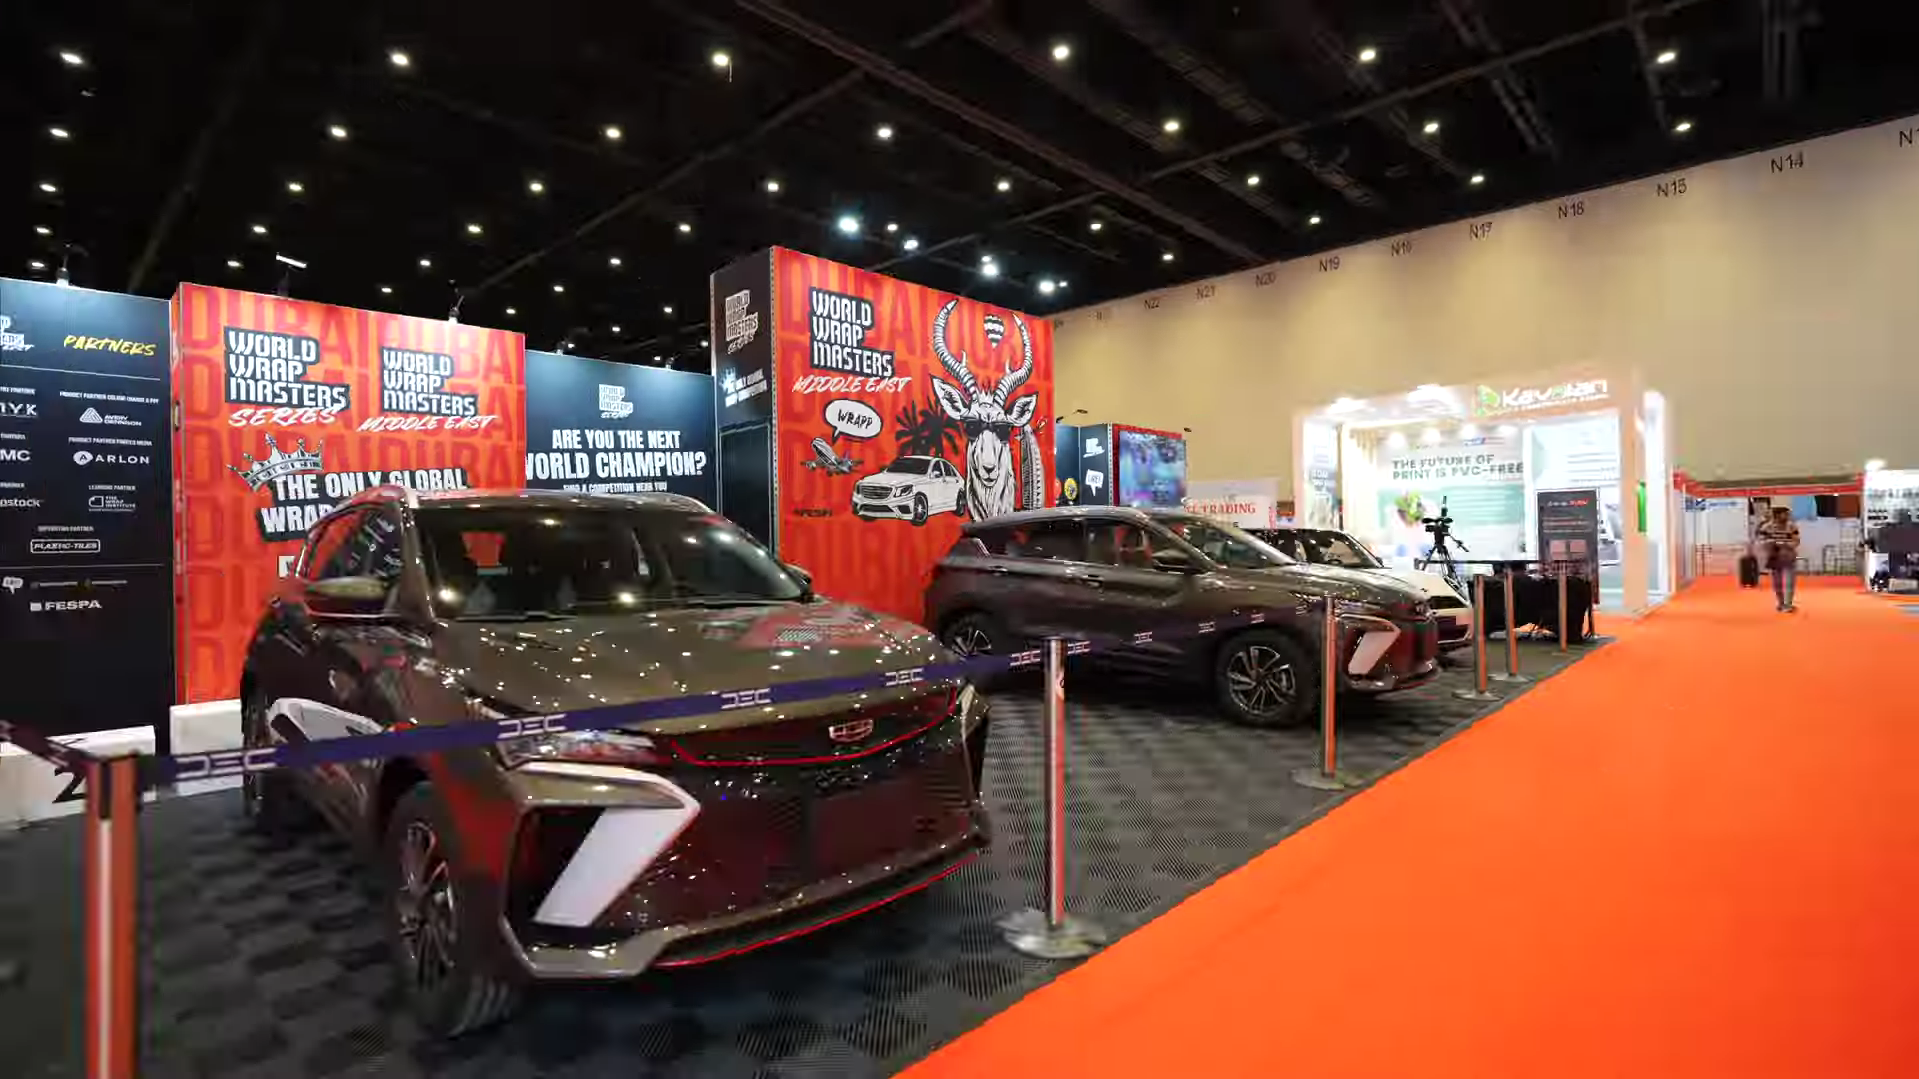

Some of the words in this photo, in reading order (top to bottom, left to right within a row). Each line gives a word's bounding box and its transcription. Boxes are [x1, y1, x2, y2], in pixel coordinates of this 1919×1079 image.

[1656, 178, 1688, 198] N15
[1318, 256, 1341, 273] N19
[1255, 271, 1277, 288] N20
[812, 291, 872, 326] WORLD
[812, 316, 863, 348] WRAP
[64, 334, 157, 357] PARTNERS
[228, 330, 317, 363] WORLD
[229, 354, 304, 385] WRAP
[383, 350, 451, 377] WORLD
[813, 342, 893, 377] MASTERS
[383, 370, 442, 394] WRAP
[792, 374, 864, 394] MIDDLE
[865, 377, 912, 394] EAST
[229, 377, 347, 410] MASTERS
[383, 391, 476, 417] MASTERS
[228, 406, 340, 428] SERIES
[356, 415, 440, 433] MIDDLE
[442, 415, 499, 431] EAST
[837, 409, 873, 430] WRAPP
[552, 429, 582, 449] ARE
[585, 430, 614, 449] YOU
[617, 430, 644, 449] THE
[647, 430, 681, 449] NEXT
[95, 453, 150, 464] ARLON
[595, 451, 707, 479] CHAMPION?
[1392, 459, 1416, 471] THE
[1420, 455, 1471, 469] FUTURE
[1476, 454, 1495, 465] OF
[1393, 468, 1432, 481] PRINT
[1436, 468, 1446, 478] IS
[1451, 461, 1525, 477] PVC-FREE
[272, 473, 320, 501] THE
[45, 600, 102, 612] FESPA
